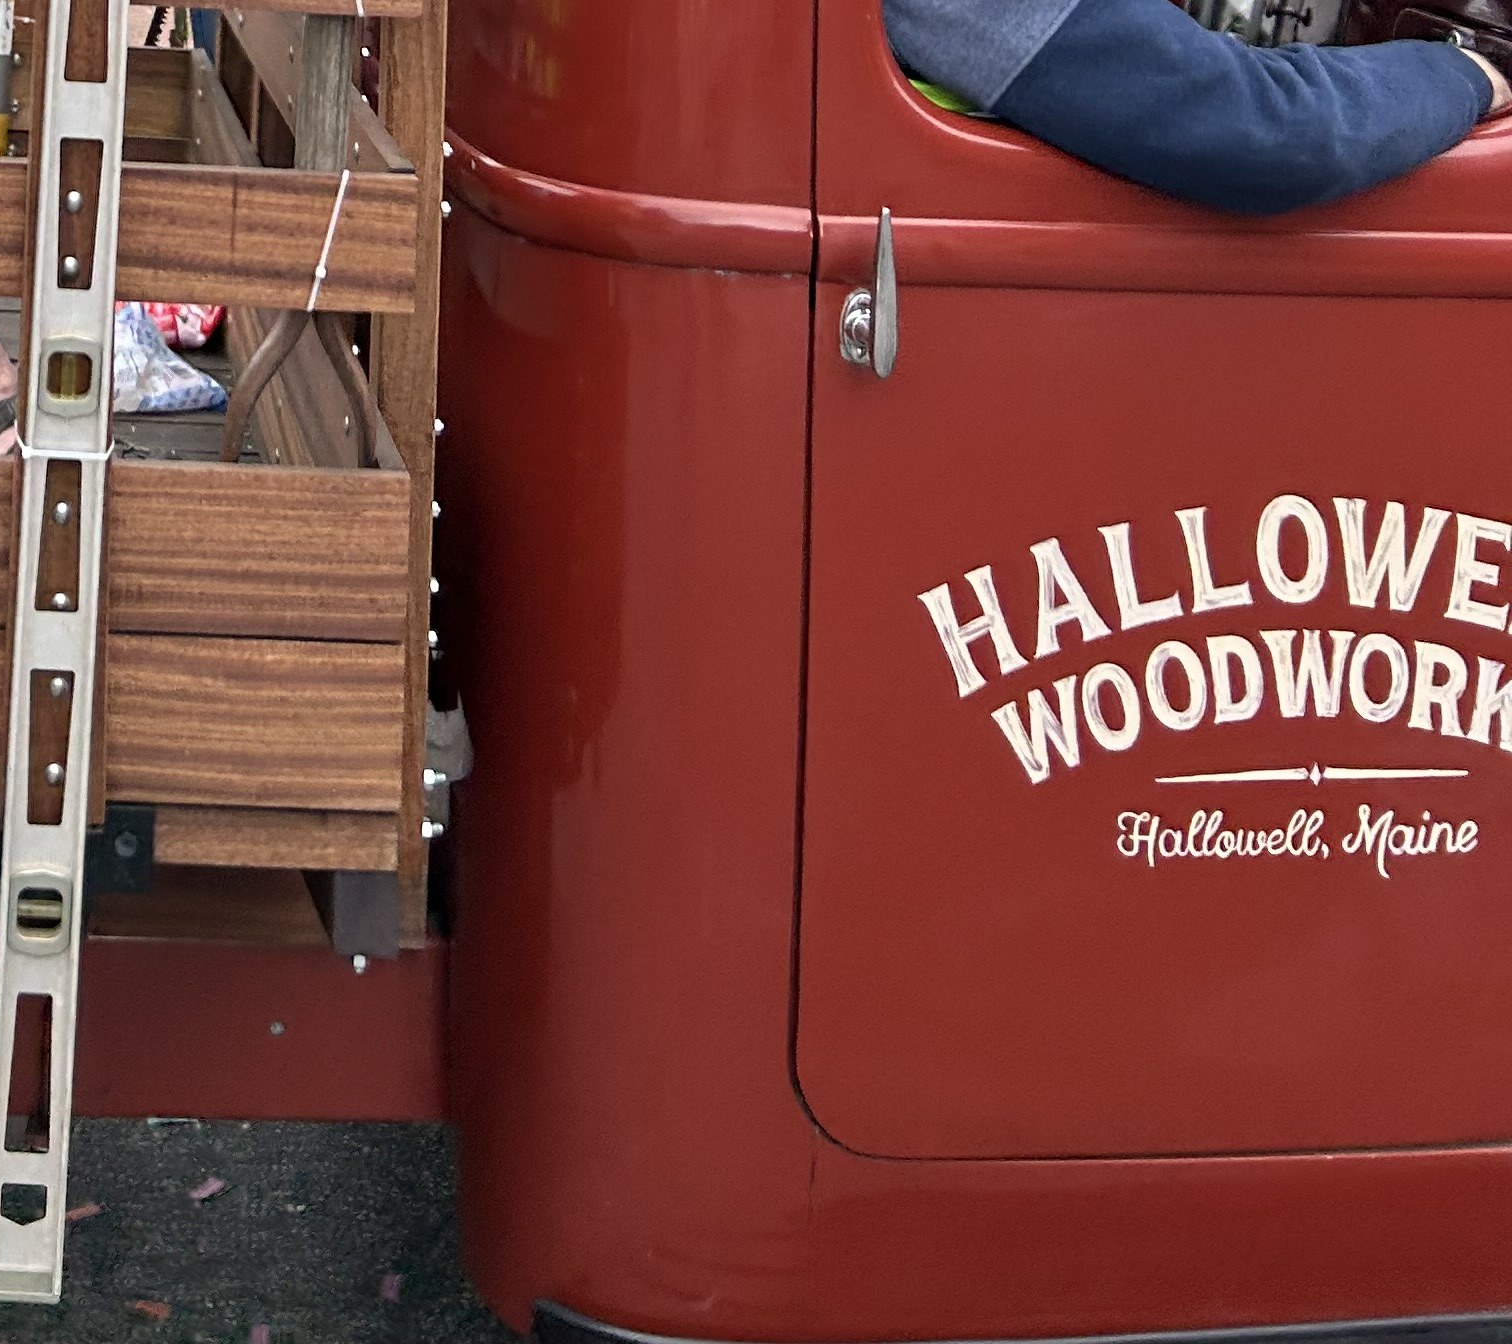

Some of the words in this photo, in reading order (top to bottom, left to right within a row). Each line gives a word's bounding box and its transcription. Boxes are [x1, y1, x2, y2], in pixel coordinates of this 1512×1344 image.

[917, 494, 1512, 698] HALLOWE
[991, 628, 1512, 785] WOODWORK
[1116, 808, 1330, 868] Hallowell,
[1341, 803, 1480, 879] Maine
